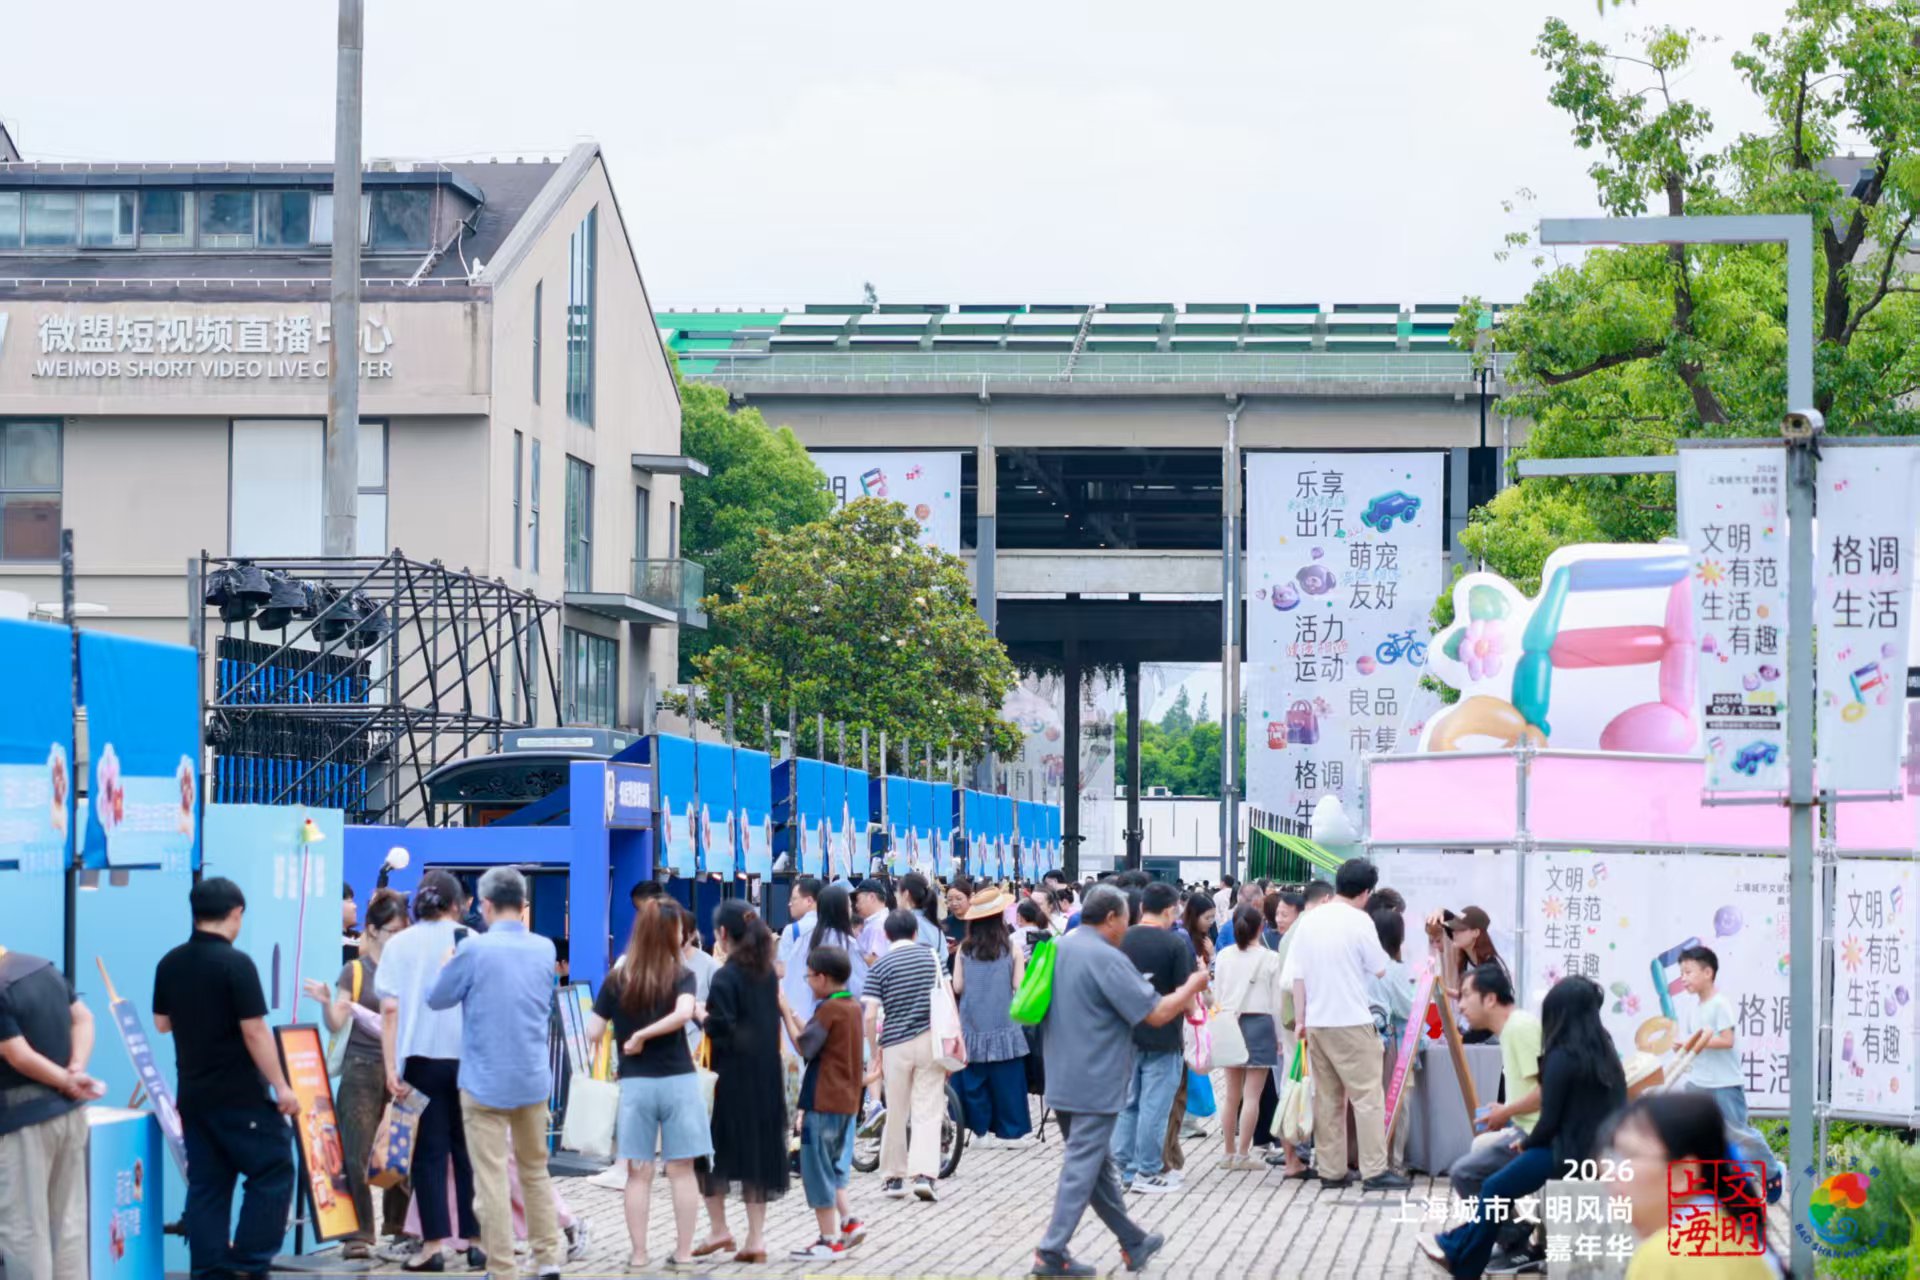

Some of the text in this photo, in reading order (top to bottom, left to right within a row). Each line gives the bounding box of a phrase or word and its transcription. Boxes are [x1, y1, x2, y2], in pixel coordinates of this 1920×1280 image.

[37, 360, 392, 377] WEIMOB SHORT VIDEO LIVE CTER
[1296, 469, 1344, 498] 乐享
[1296, 508, 1344, 537] 出行
[1701, 523, 1751, 554] 文明
[1349, 541, 1398, 571] 萌宠
[1832, 535, 1900, 576] 格调
[1727, 557, 1778, 588] 有范
[1349, 580, 1398, 610] 友好
[1701, 591, 1751, 621] 生活
[1832, 589, 1899, 629] 生活
[1295, 613, 1343, 643] 活力
[1728, 624, 1778, 656] 有趣
[1295, 653, 1343, 682] 运动
[1349, 688, 1397, 716] 良品
[1349, 726, 1397, 753] 市集
[1295, 760, 1343, 790] 格调
[1545, 865, 1584, 893] 文明
[1564, 895, 1602, 922] 有范
[1847, 889, 1883, 929] 文明
[1544, 922, 1581, 949] 生活
[1564, 952, 1601, 979] 有趣
[1865, 934, 1901, 974] 有范
[1848, 979, 1880, 1018] 生活
[1862, 1024, 1900, 1065] 有趣
